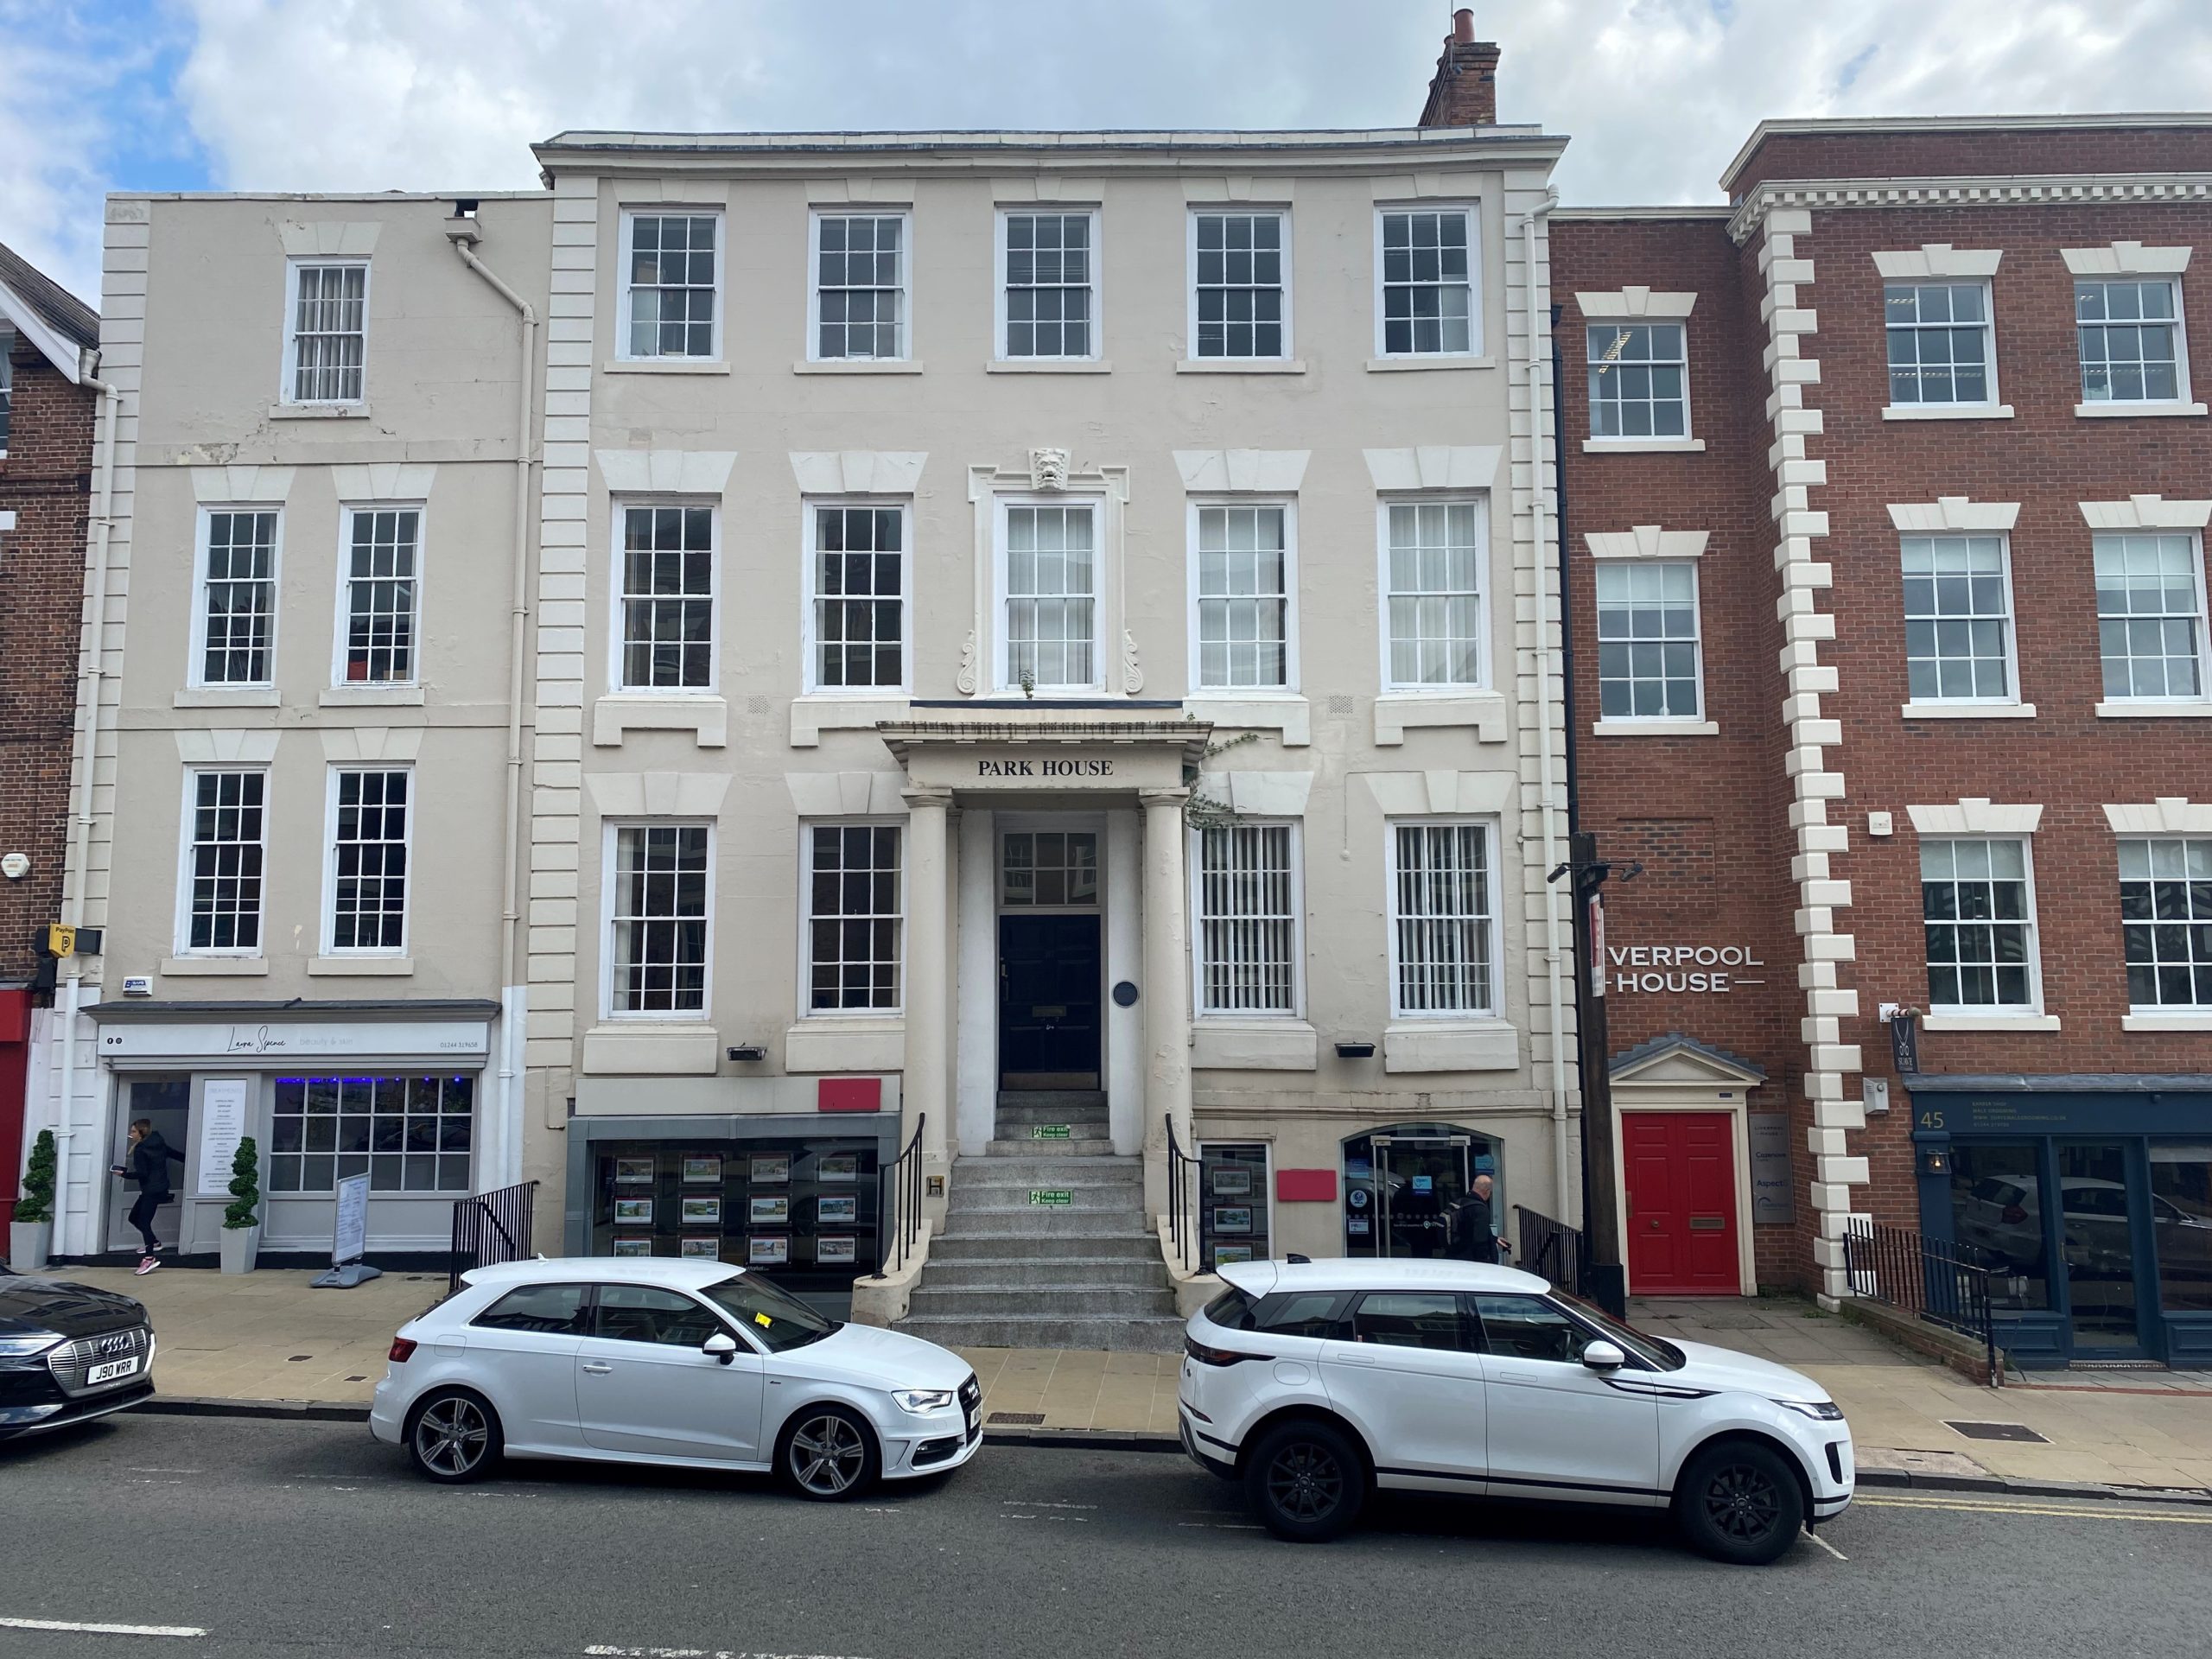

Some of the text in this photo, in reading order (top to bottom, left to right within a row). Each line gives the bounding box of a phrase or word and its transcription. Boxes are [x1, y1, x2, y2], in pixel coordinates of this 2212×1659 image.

[978, 760, 1114, 776] PARK HOUSE
[1608, 946, 1764, 966] VERPOOL
[1618, 973, 1730, 993] HOUSE
[227, 1026, 254, 1052] Laura
[256, 1025, 286, 1052] Spence
[300, 1037, 327, 1046] beauty
[1921, 1112, 1944, 1128] 45
[929, 1178, 942, 1195] H
[96, 1360, 132, 1380] J90 WRR
